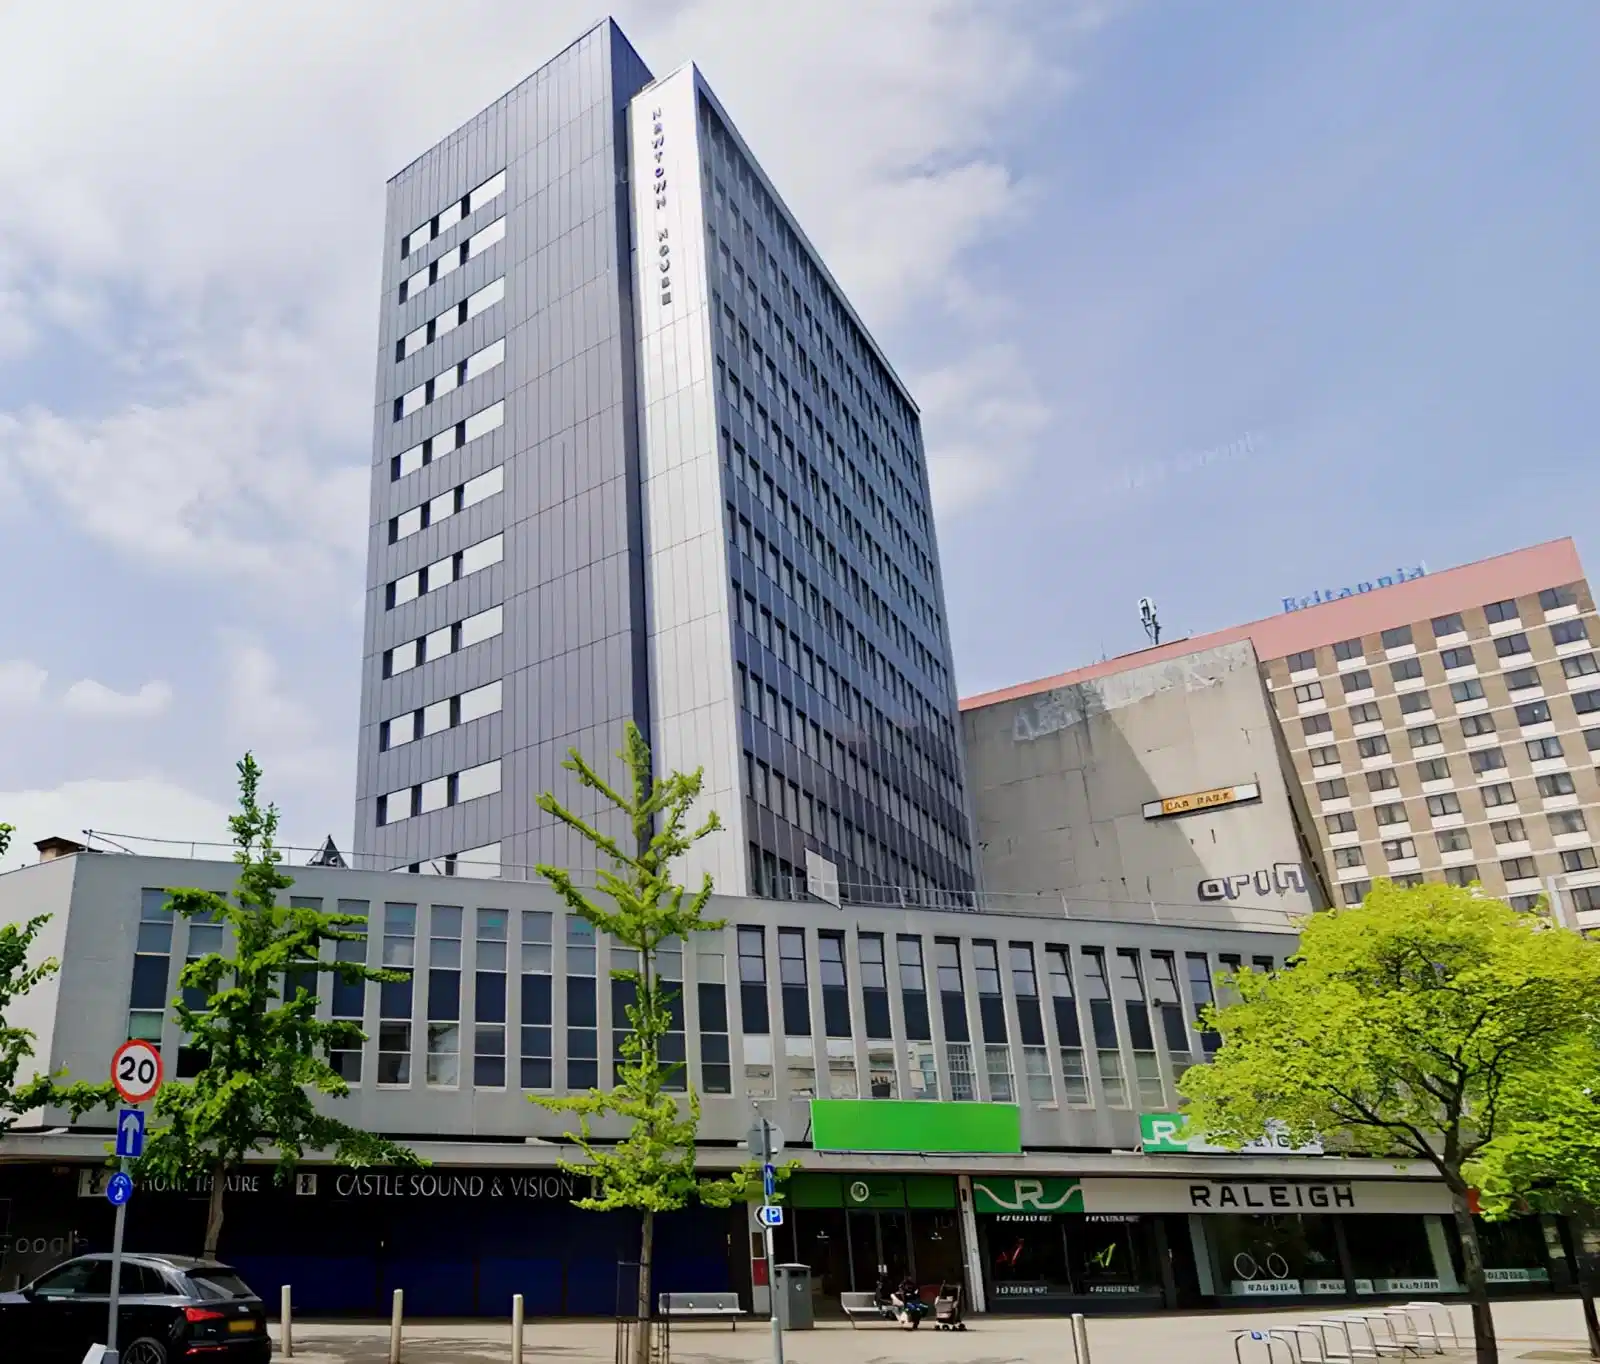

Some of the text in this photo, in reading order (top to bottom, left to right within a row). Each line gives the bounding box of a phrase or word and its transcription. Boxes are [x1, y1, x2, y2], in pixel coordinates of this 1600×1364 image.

[119, 1056, 155, 1085] 20
[191, 1175, 260, 1192] THATRE
[336, 1174, 575, 1198] CASTLE SOUND & VISION
[1189, 1185, 1355, 1208] RALEIGH
[770, 1209, 779, 1222] P
